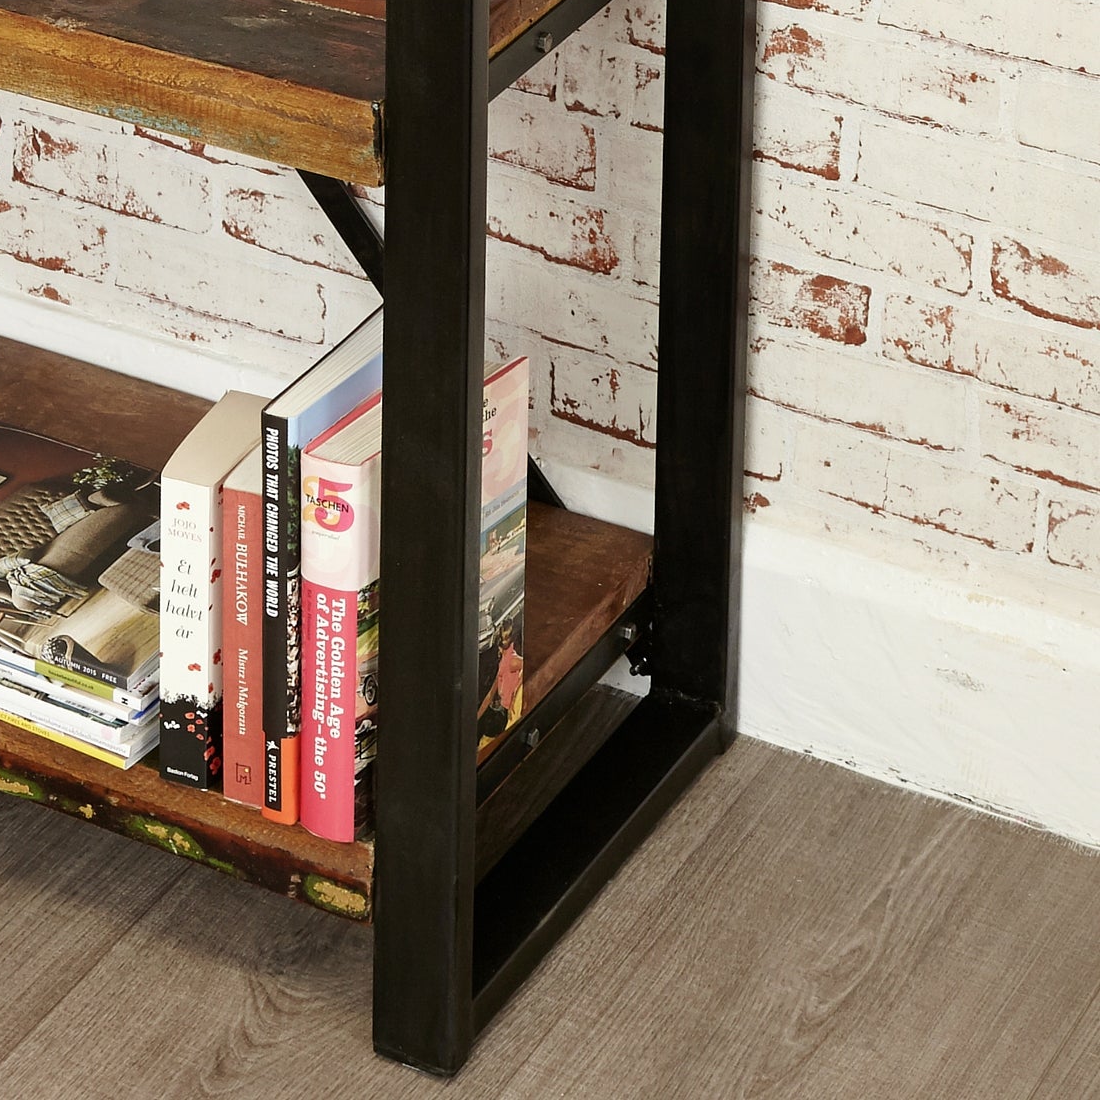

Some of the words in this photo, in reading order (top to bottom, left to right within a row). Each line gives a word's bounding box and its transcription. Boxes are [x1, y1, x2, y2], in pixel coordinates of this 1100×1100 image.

[266, 426, 279, 471] PHOTOS
[266, 473, 279, 501] THAT
[305, 494, 349, 513] TASCHEN
[168, 528, 202, 543] MOYES
[172, 518, 196, 530] JOJO
[266, 502, 279, 553] CHANGED
[177, 559, 191, 575] Et
[266, 556, 279, 577] THE
[171, 579, 198, 598] helt
[236, 543, 247, 626] BUŁHAKOW
[266, 579, 279, 618] WORLD
[166, 599, 202, 622] halvt
[316, 593, 329, 614] of
[331, 598, 345, 633] The
[175, 625, 194, 639] år
[54, 656, 81, 671] AUTUMN
[83, 666, 97, 677] 2015
[101, 673, 118, 684] FREE
[238, 648, 248, 678] Mistrz
[330, 636, 345, 699] Golden
[327, 702, 344, 739] Age
[268, 754, 277, 803] PRESTEL
